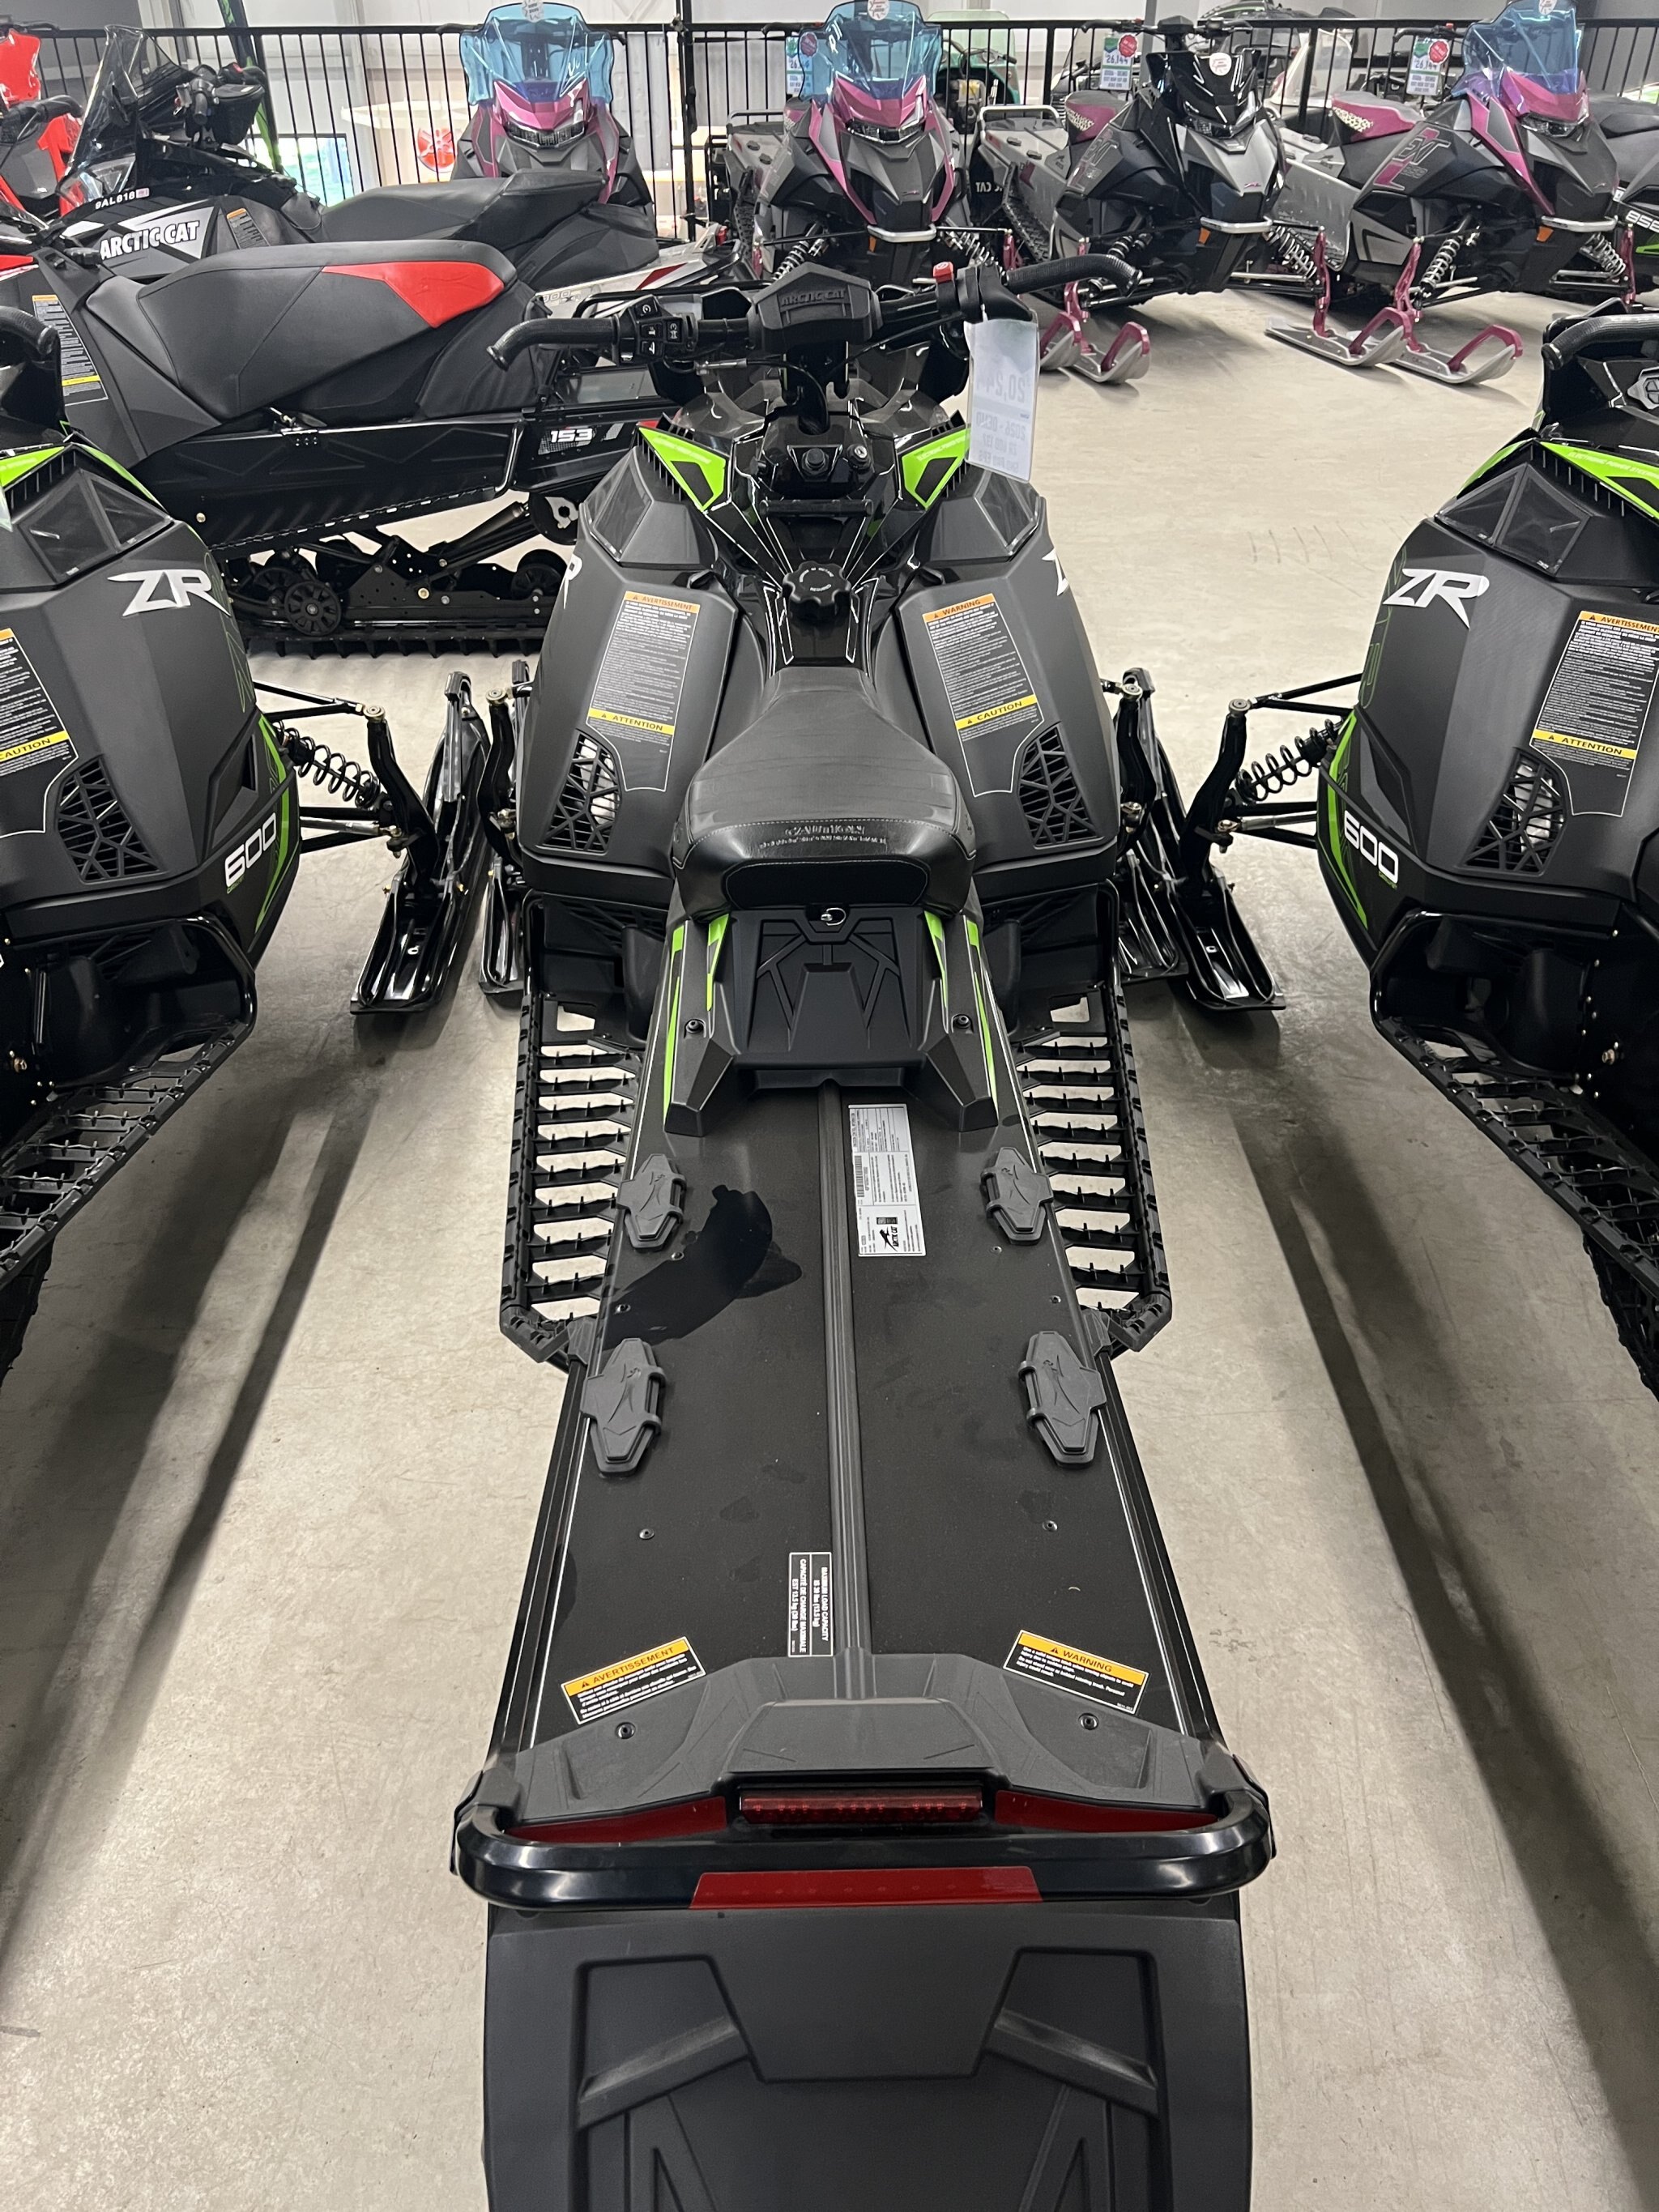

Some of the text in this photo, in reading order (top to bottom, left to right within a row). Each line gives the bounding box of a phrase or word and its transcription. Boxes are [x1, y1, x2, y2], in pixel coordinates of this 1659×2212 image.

[100, 226, 162, 261] ARCTIC
[164, 219, 200, 245] CAT
[781, 288, 847, 307] ARCTIC CAT
[550, 428, 593, 443] 153
[107, 569, 231, 617] ZR
[642, 595, 693, 612] AVERTISSEMENT
[1383, 569, 1490, 629] ZR
[942, 599, 981, 616] WARNING
[977, 700, 1022, 722] CAUTION
[612, 714, 663, 731] ATTENTION
[1562, 736, 1623, 756] ATTENTION
[593, 1647, 675, 1683] AVERTISSEMENT
[1063, 1650, 1113, 1673] WARNING
